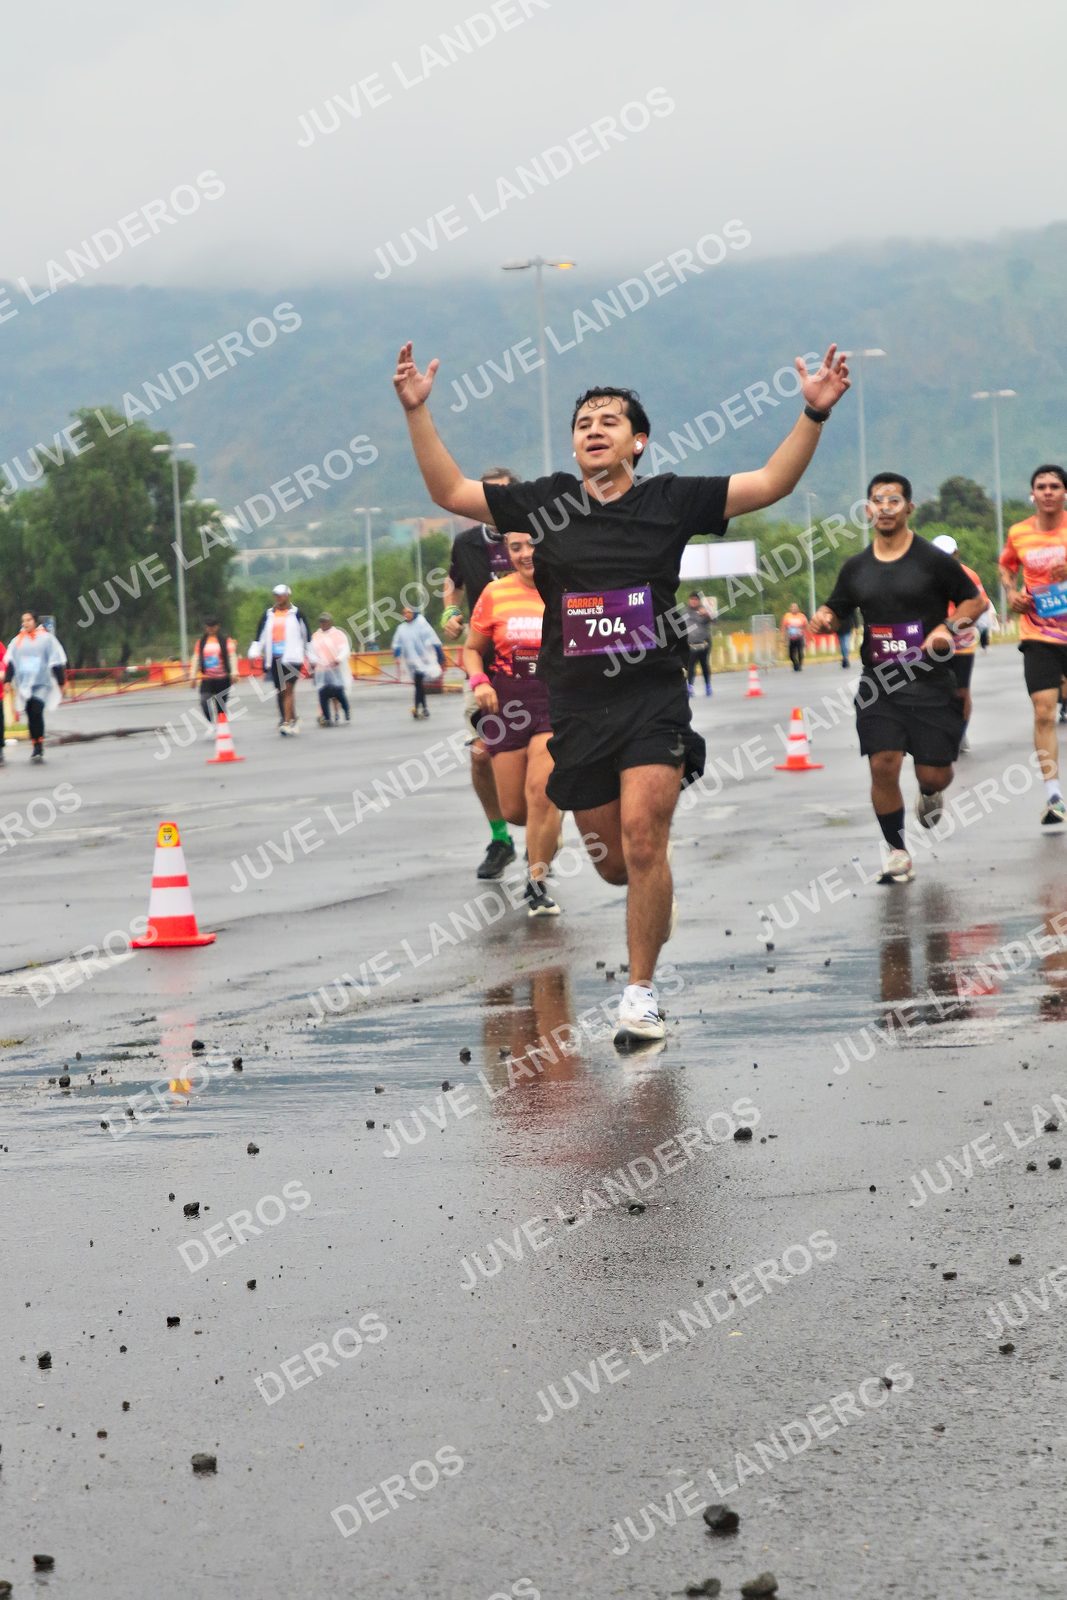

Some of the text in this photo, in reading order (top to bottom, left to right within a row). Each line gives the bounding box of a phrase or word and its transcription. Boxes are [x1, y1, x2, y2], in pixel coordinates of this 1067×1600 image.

[567, 597, 604, 608] CARRERA
[585, 616, 626, 637] 704
[882, 640, 907, 653] 368
